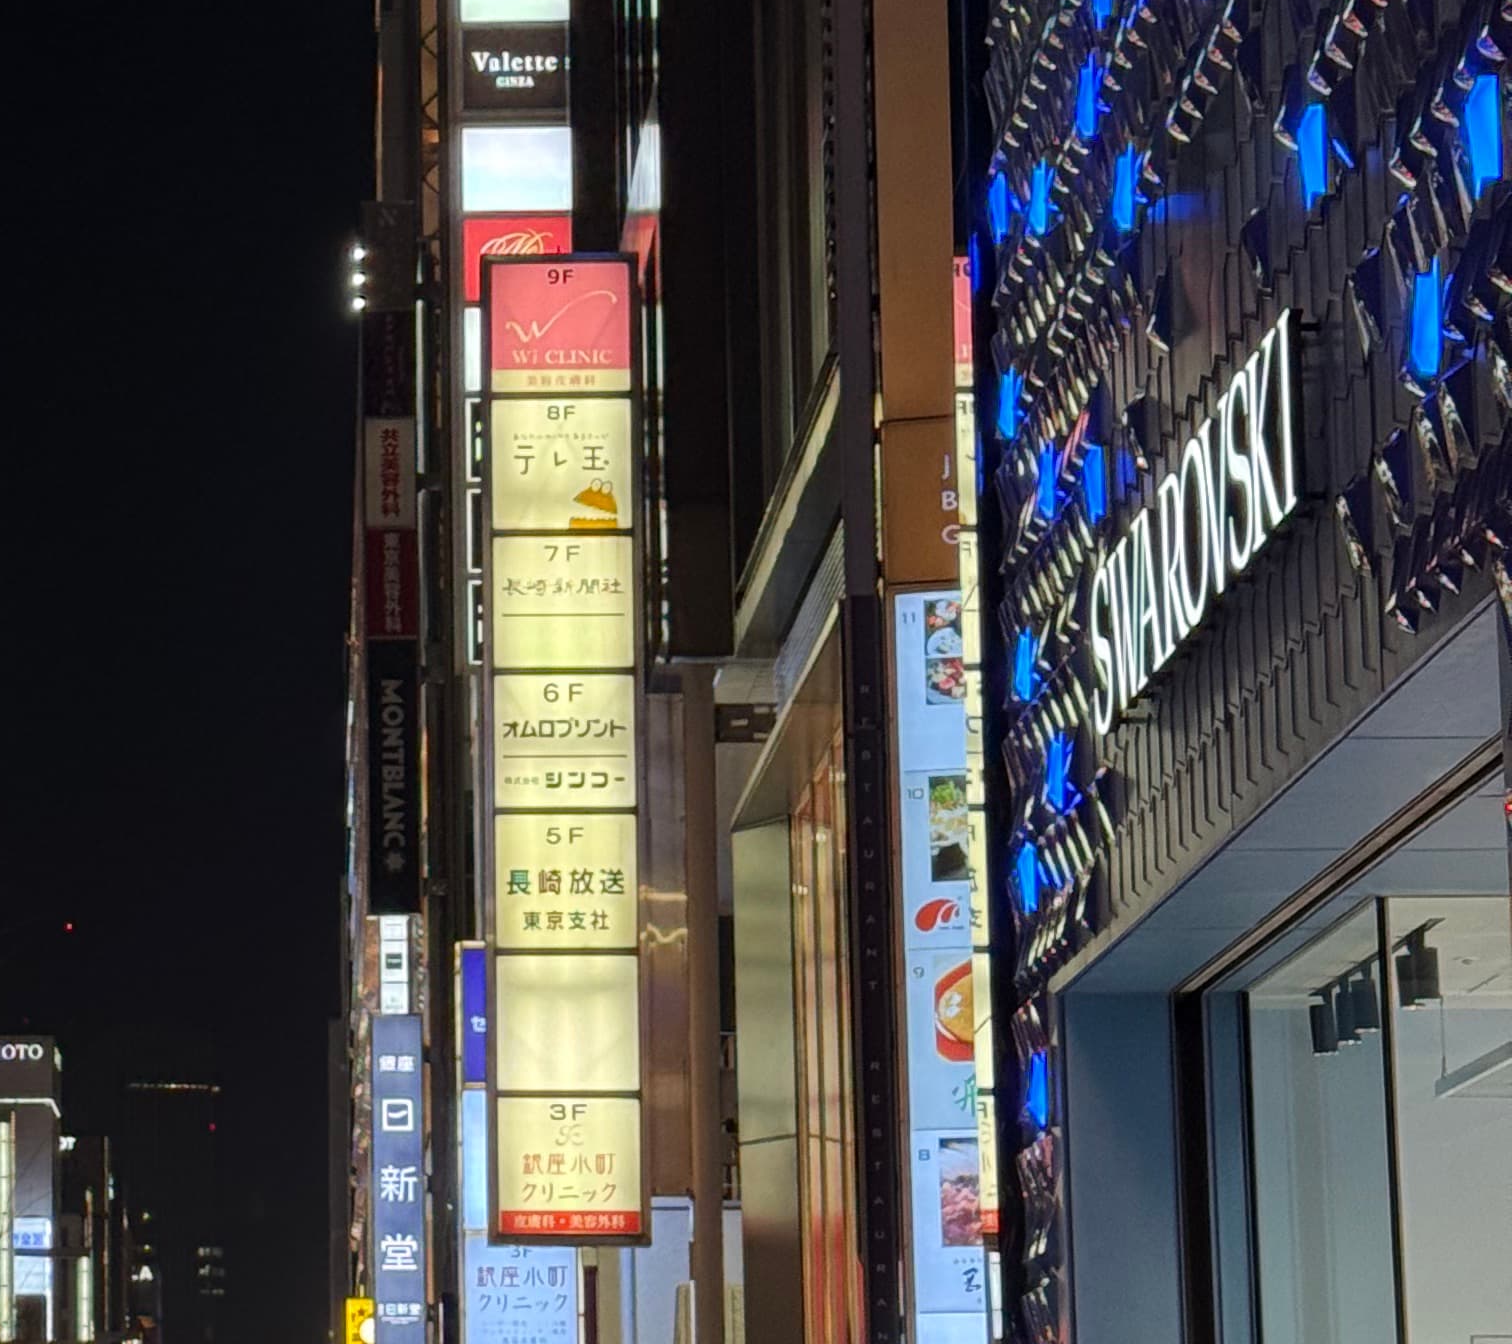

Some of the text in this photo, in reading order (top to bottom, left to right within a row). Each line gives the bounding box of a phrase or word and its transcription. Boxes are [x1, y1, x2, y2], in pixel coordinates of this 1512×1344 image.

[471, 51, 559, 73] Valette
[547, 269, 575, 285] 9F
[544, 349, 613, 364] CLINIC
[546, 405, 577, 420] 8F
[1090, 307, 1298, 737] SWAROVSKI
[544, 545, 581, 561] 7F
[543, 682, 585, 703] 6F
[380, 678, 407, 849] MONTBLANC
[546, 826, 584, 845] 5F
[506, 869, 626, 895] 長崎放送
[522, 910, 610, 931] 東京支社
[549, 1104, 588, 1121] 3F
[380, 1098, 419, 1272] 日新堂
[522, 1182, 617, 1203] クリニック
[479, 1293, 568, 1313] クリニック
